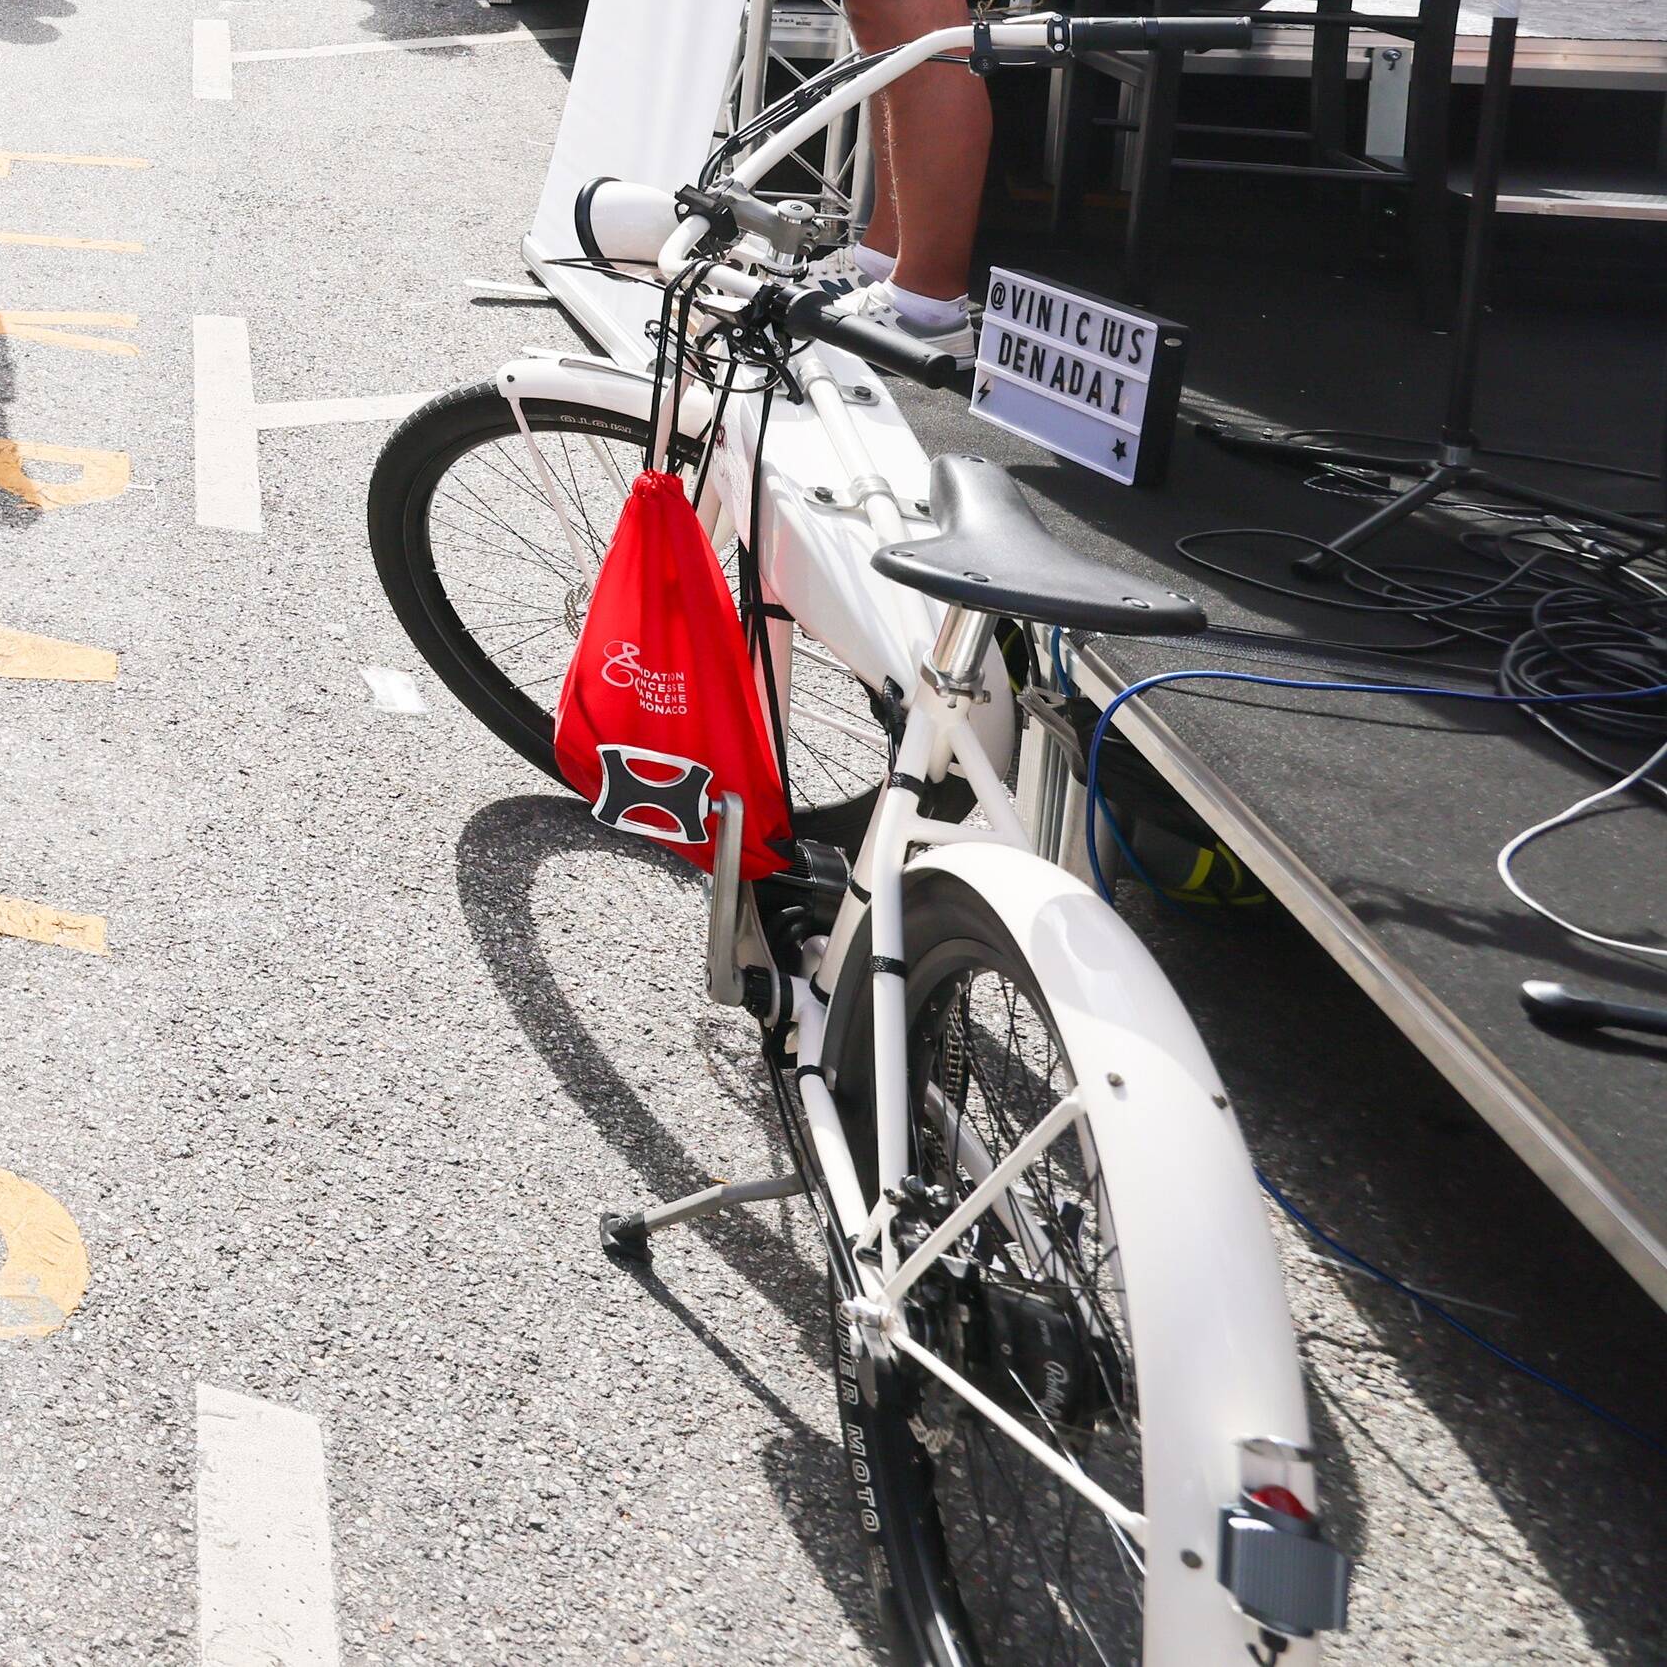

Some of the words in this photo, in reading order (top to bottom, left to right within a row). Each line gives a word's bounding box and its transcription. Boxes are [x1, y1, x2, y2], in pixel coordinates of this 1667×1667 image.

[990, 281, 1145, 365] @VINICIUS
[998, 332, 1125, 416] DENADAI
[844, 1422, 880, 1533] MOTO
